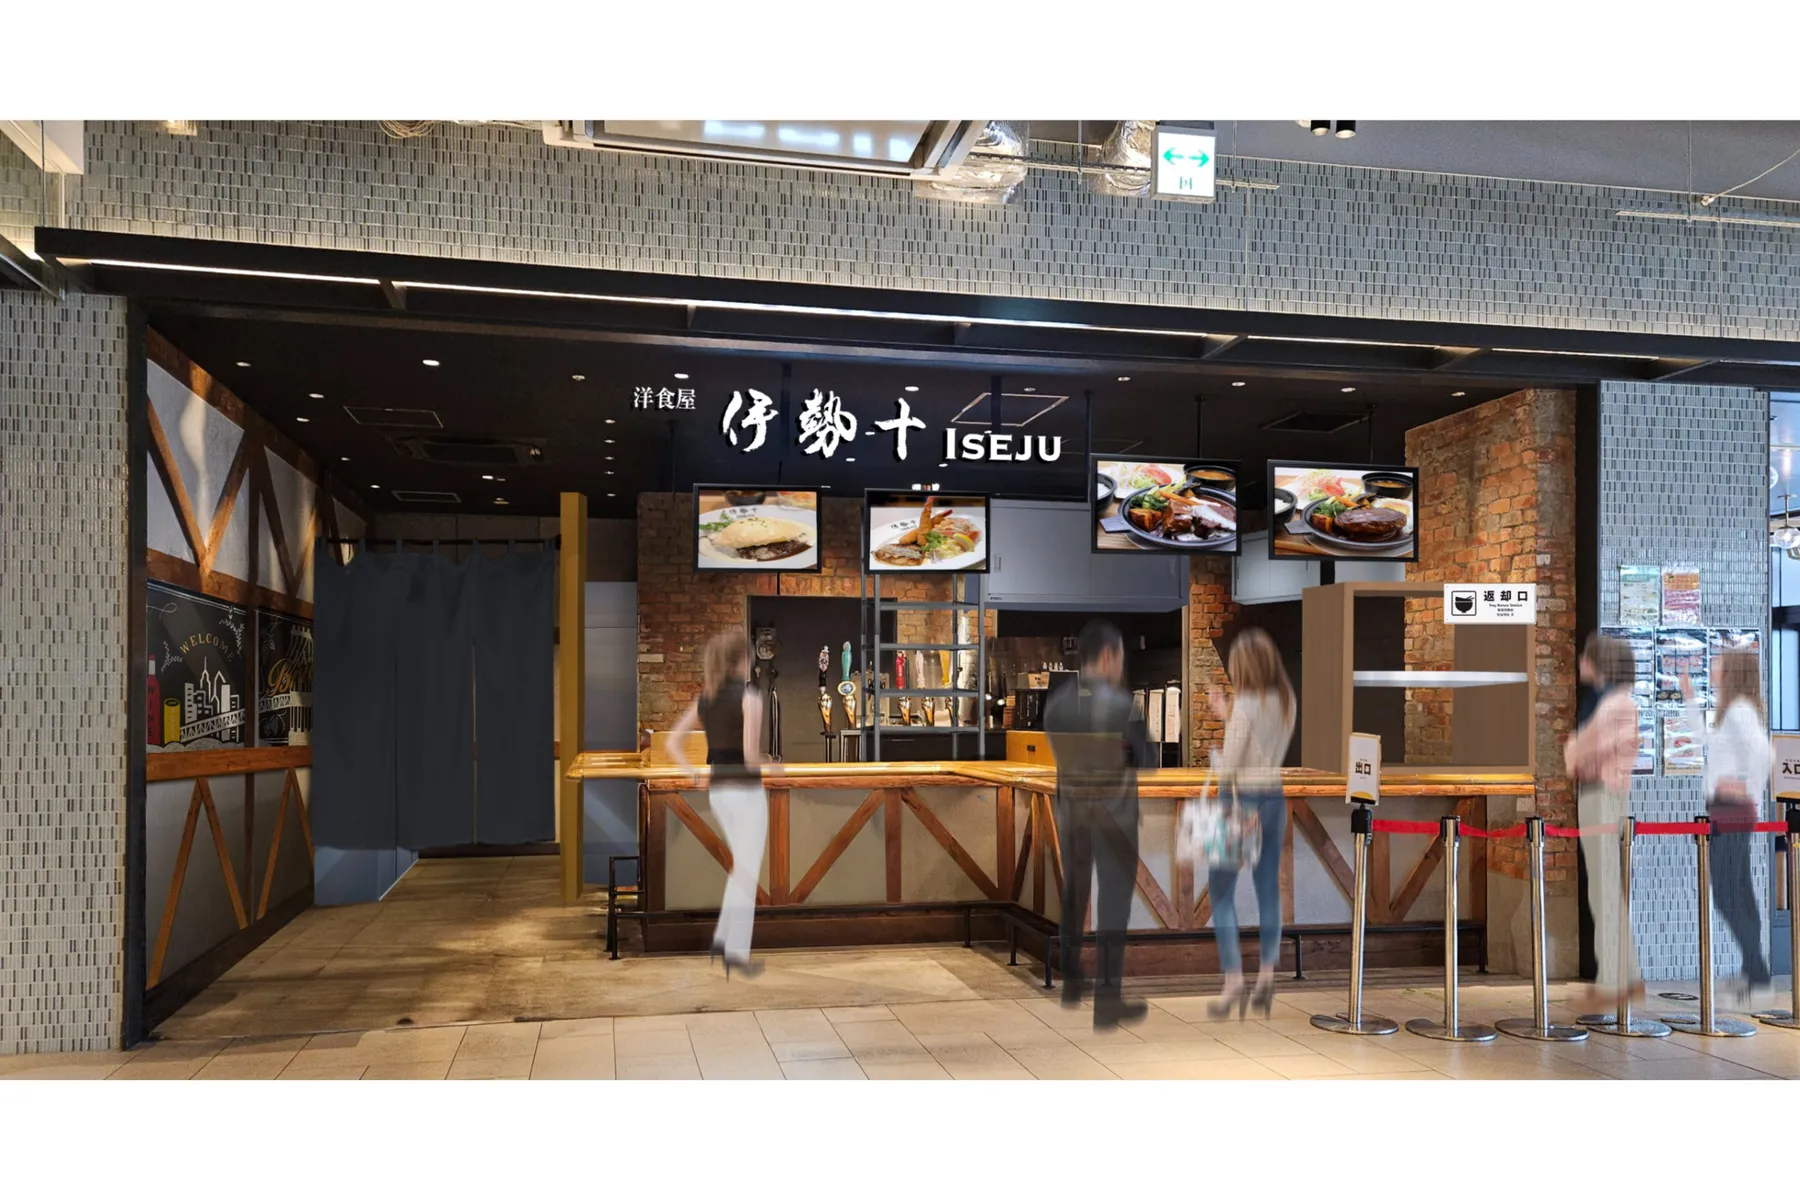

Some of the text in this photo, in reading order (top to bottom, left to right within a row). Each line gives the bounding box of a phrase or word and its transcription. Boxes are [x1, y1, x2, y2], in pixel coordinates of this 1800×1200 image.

[633, 387, 696, 410] 洋食屋
[722, 388, 926, 460] 伊勢十
[946, 427, 1062, 462] ISEJU
[1483, 590, 1528, 602] 返却口
[180, 633, 235, 662] WELCOME
[1355, 761, 1371, 776] 出口
